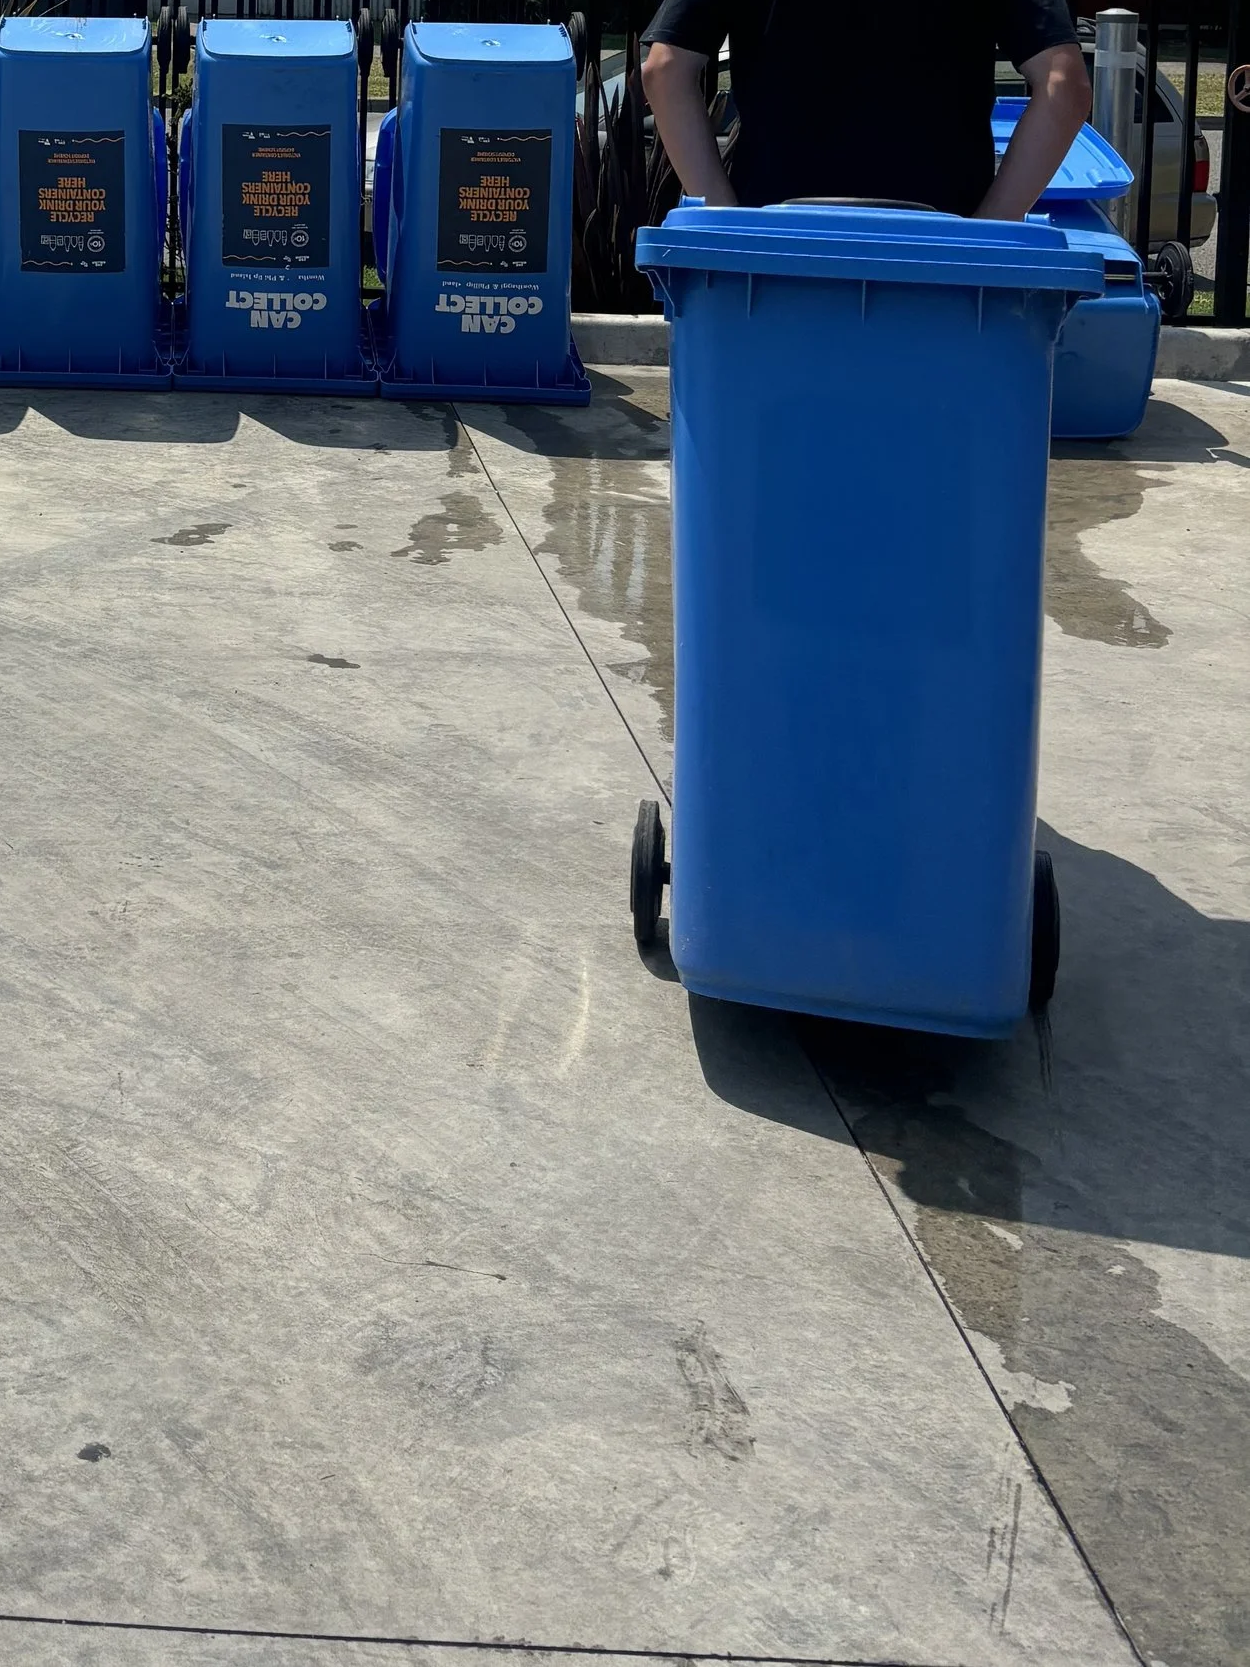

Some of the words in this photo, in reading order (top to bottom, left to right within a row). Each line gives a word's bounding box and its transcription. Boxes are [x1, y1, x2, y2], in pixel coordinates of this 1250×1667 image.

[262, 171, 290, 181] HERE
[480, 176, 509, 186] HERE
[57, 177, 86, 187] HERE
[242, 182, 310, 193] CONTAINERS
[39, 188, 105, 198] CONTAINERS
[459, 187, 530, 198] CONTAINERS
[39, 200, 73, 210] DRINK
[75, 200, 105, 210] YOUR
[242, 194, 277, 205] DRINK
[279, 194, 310, 205] YOUR
[459, 198, 495, 209] DRINK
[497, 199, 529, 210] YOUR
[254, 206, 298, 216] RECYCLE
[471, 211, 517, 221] RECYCLE
[50, 212, 94, 222] RECYCLE
[226, 290, 327, 310] COLLECT
[435, 294, 543, 314] COLLECT
[251, 311, 301, 329] CAN
[461, 314, 515, 334] CAN
